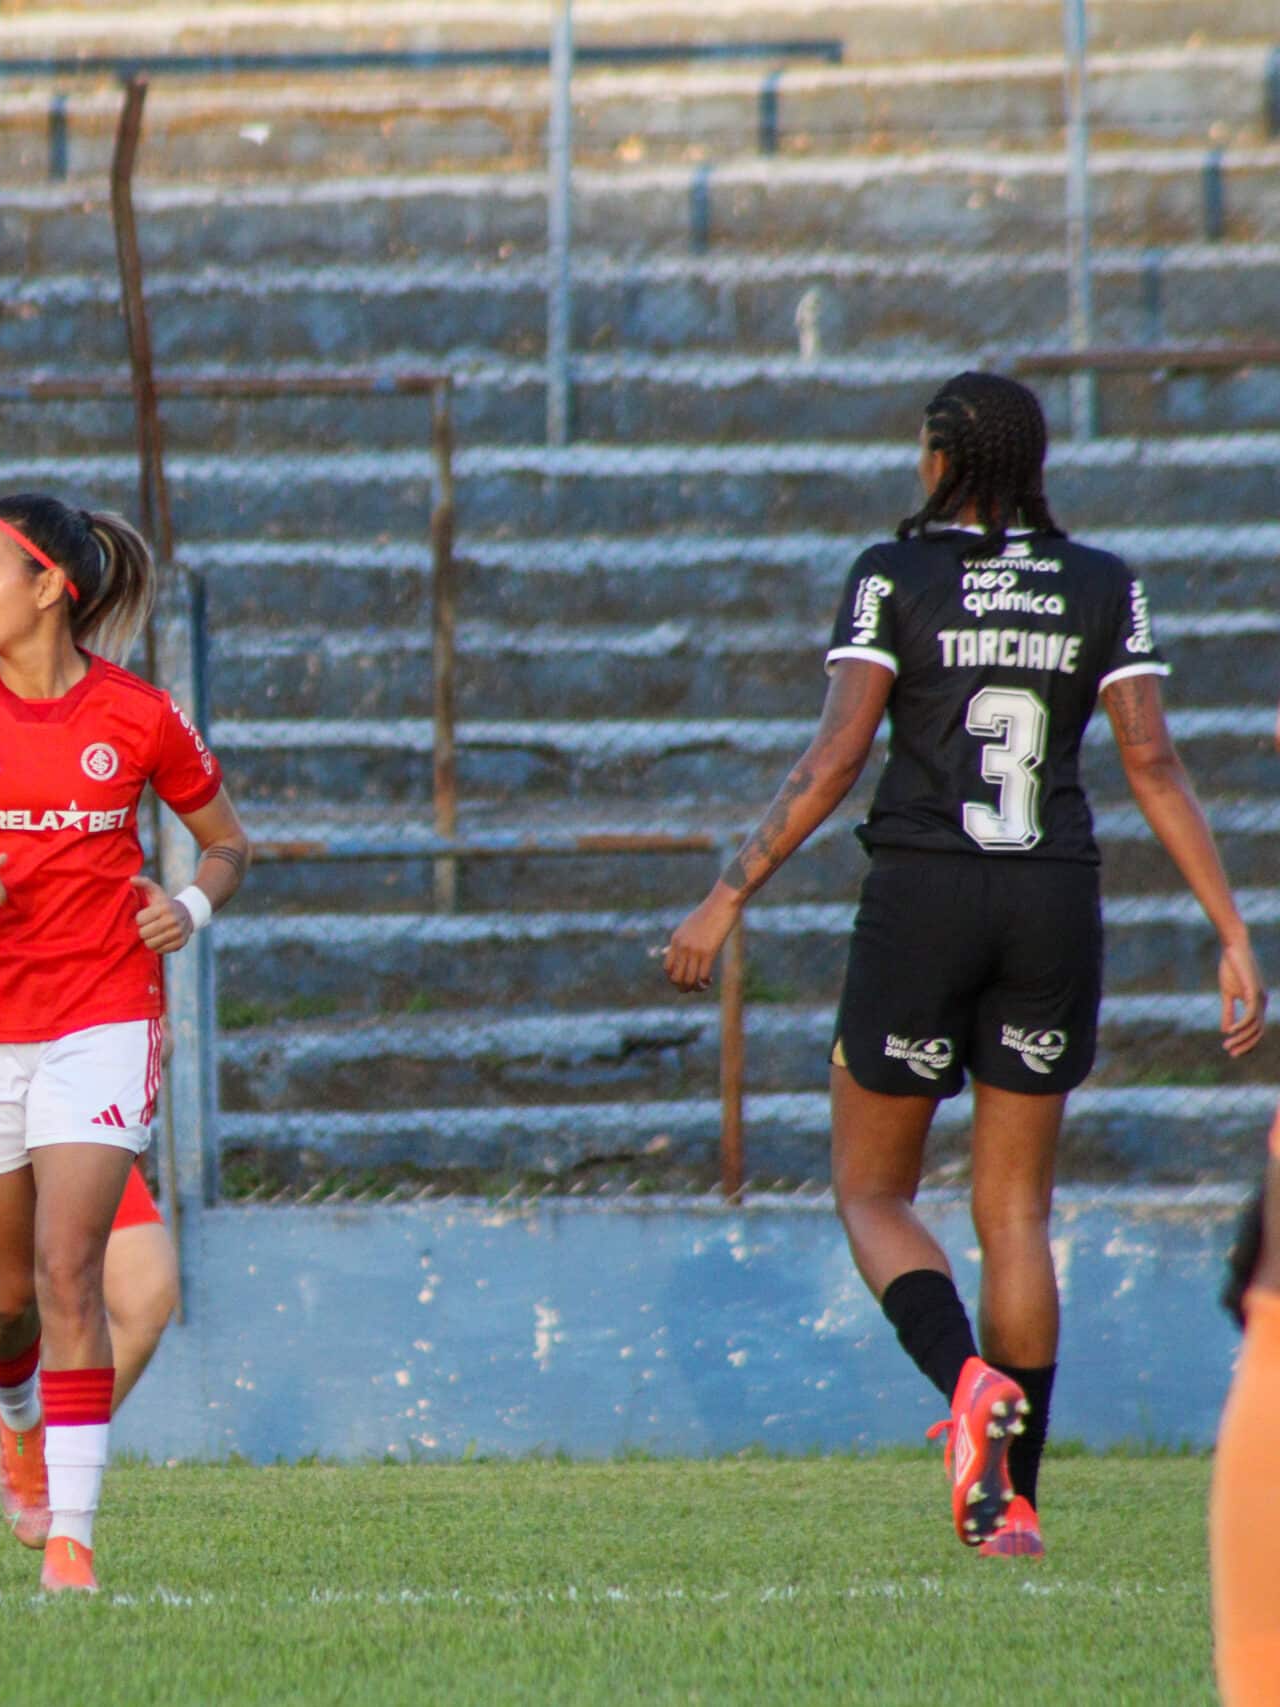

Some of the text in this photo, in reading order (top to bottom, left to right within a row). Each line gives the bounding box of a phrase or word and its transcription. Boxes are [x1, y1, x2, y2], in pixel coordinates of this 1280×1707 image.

[962, 570, 1018, 592] neo
[852, 574, 895, 629] bmg
[963, 588, 1065, 617] química
[1125, 597, 1153, 653] bmg
[937, 628, 1083, 674] TARCIANE
[963, 685, 1048, 851] 3
[88, 805, 130, 833] BET
[886, 1033, 909, 1049] Uni
